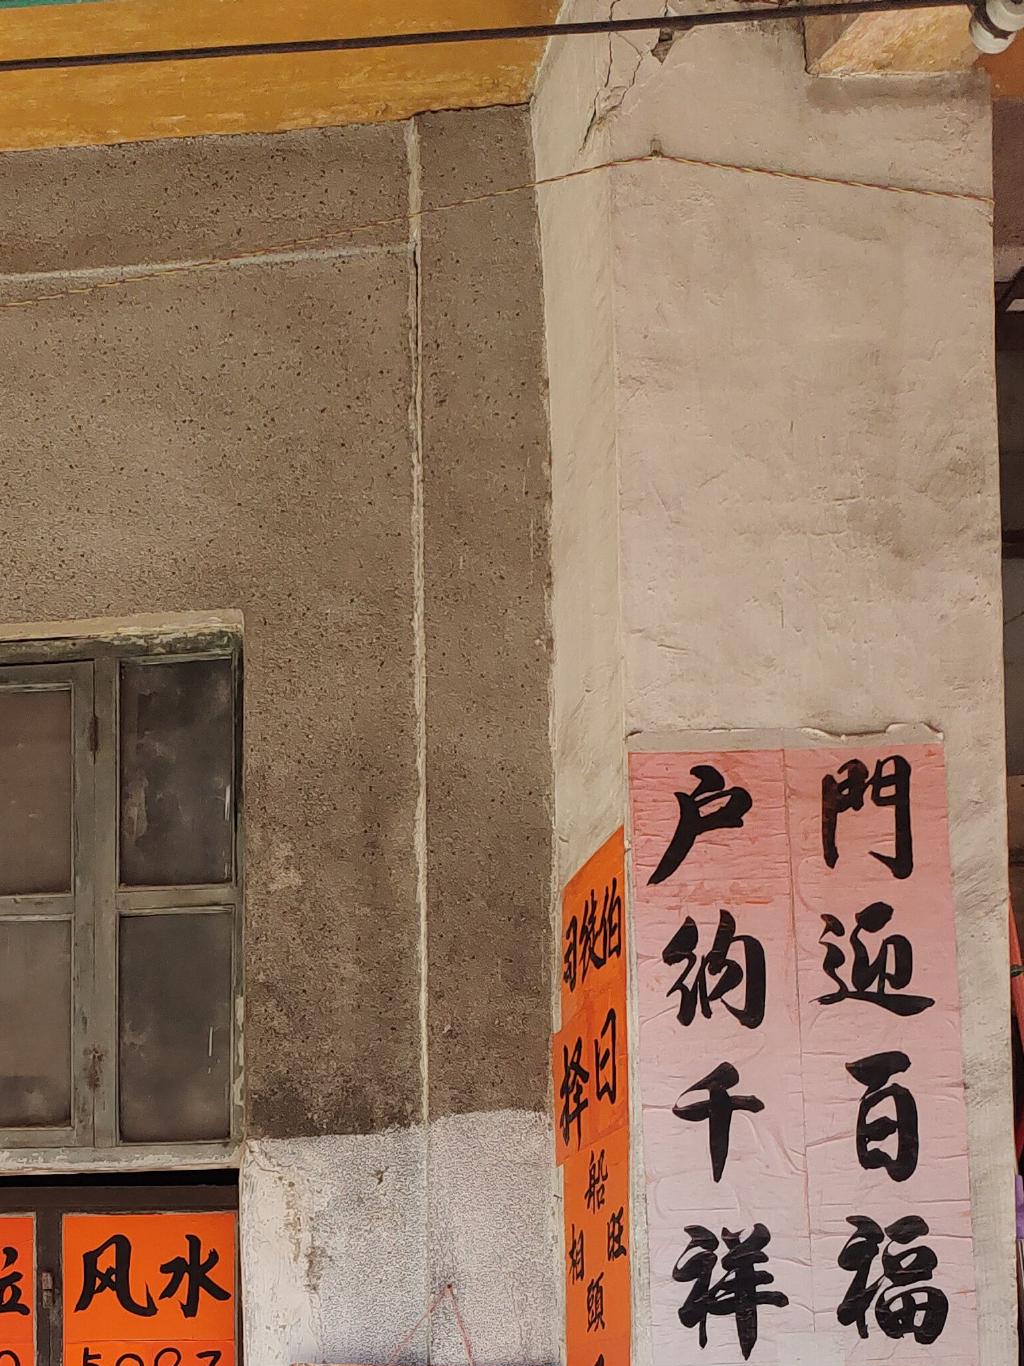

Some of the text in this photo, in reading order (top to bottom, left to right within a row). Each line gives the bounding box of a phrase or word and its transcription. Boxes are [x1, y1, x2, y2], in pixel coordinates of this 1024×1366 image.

[562, 878, 622, 993] 司徒伯
[560, 1008, 618, 1152] 择日
[815, 754, 949, 1345] 門迎百福
[75, 1235, 232, 1319] 风水
